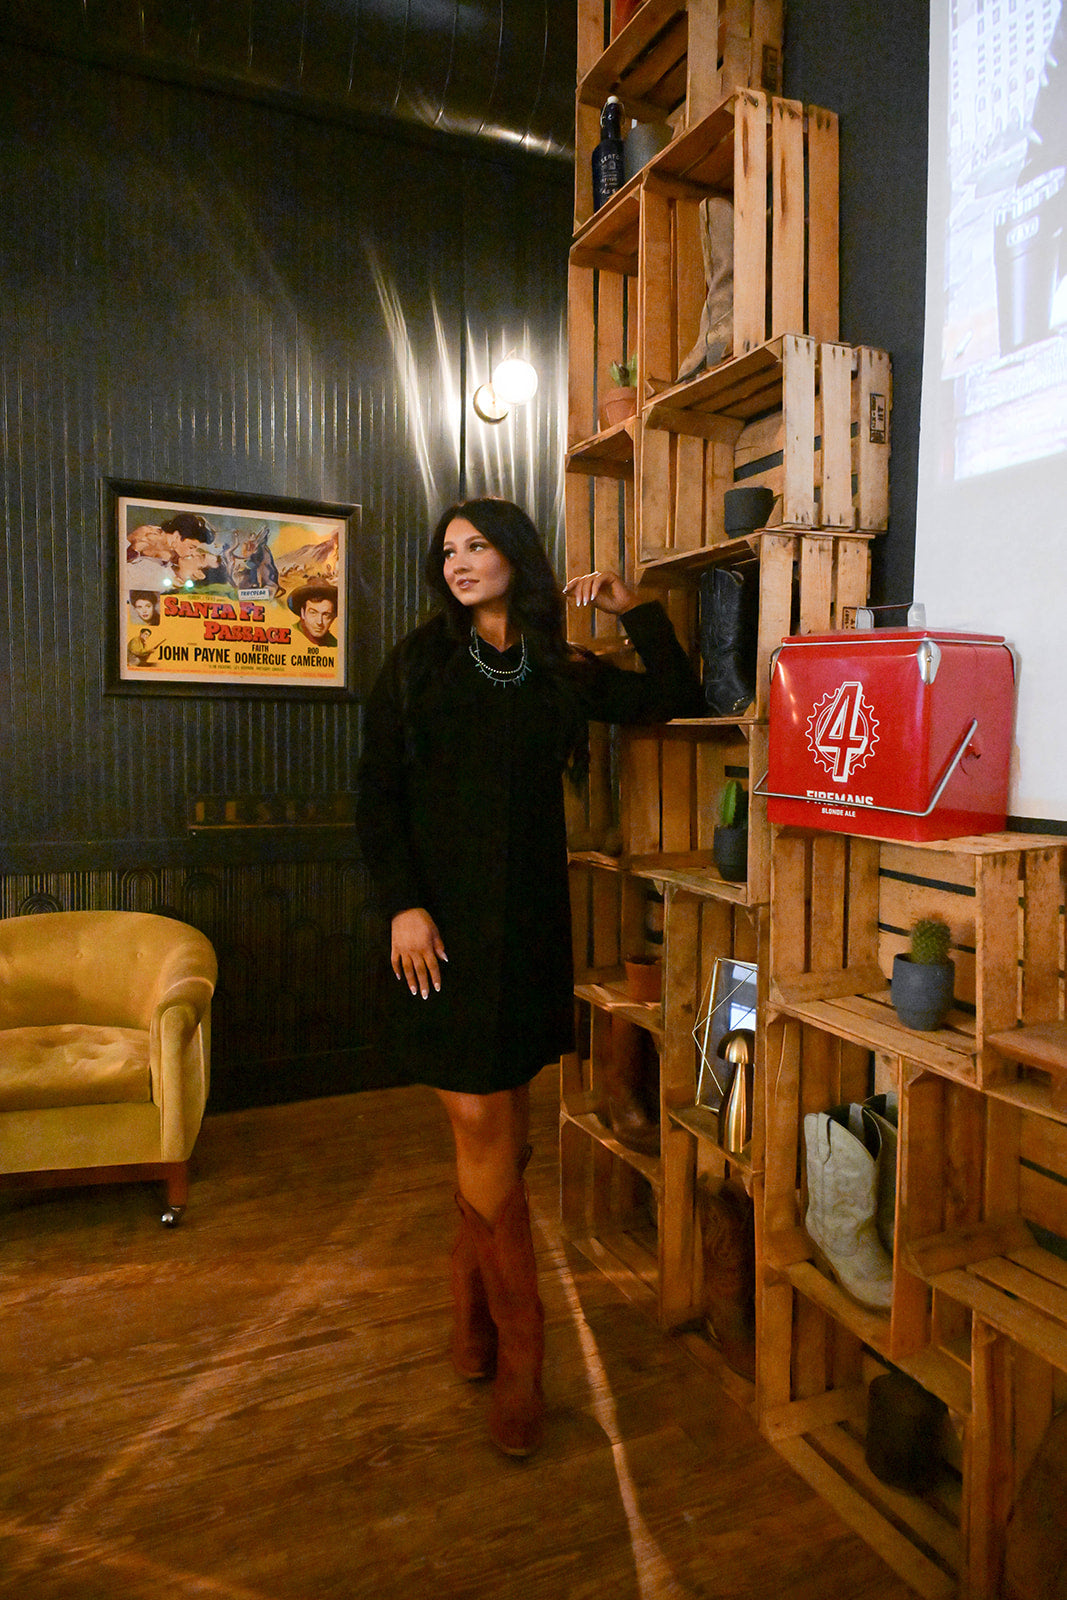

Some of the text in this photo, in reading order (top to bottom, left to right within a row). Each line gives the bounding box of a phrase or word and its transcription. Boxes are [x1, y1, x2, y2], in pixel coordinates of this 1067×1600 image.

[164, 597, 265, 622] SANTA FE
[204, 620, 291, 644] PASSAGE
[158, 645, 189, 661] JOHN
[194, 647, 231, 663] PAYNE
[234, 652, 287, 666] DOMERGUE
[291, 655, 335, 668] CAMERON
[252, 644, 269, 652] FAITH
[307, 647, 320, 655] ROD
[821, 807, 856, 818] BLONDE ALE
